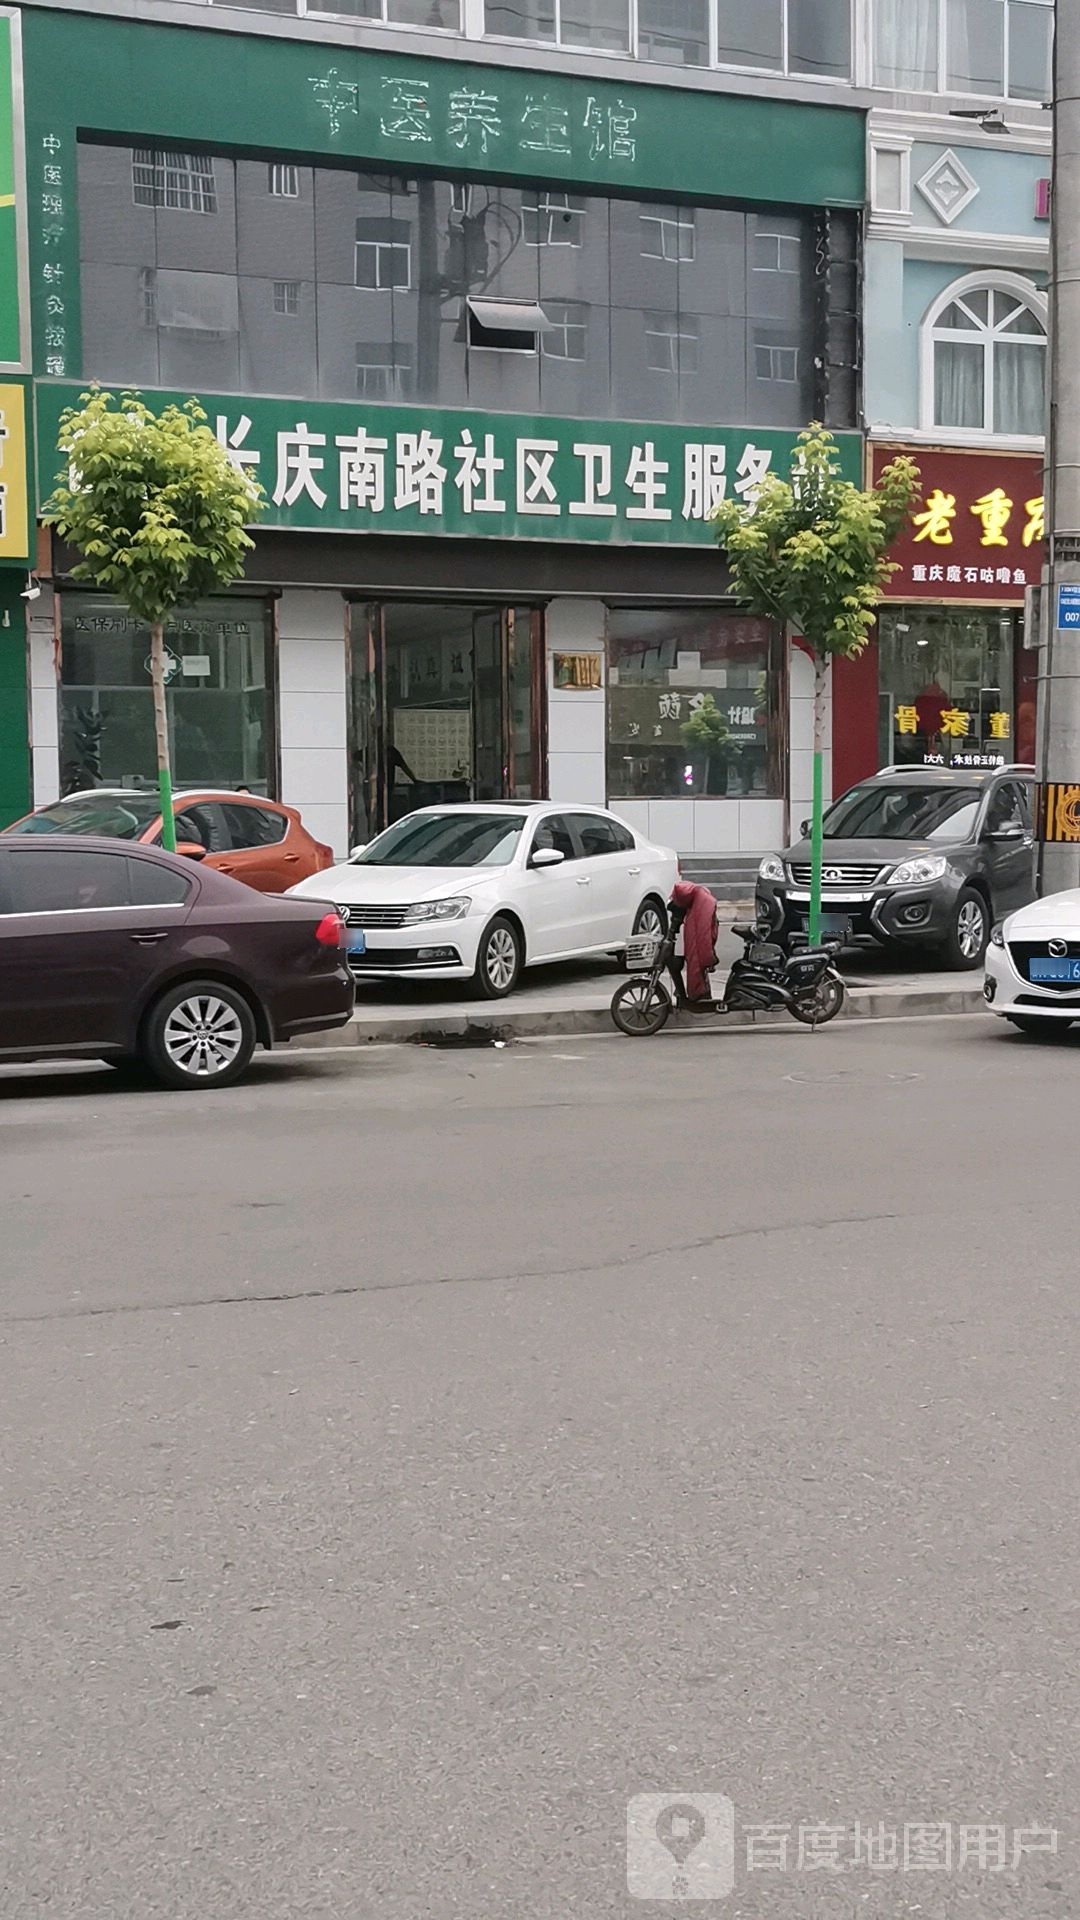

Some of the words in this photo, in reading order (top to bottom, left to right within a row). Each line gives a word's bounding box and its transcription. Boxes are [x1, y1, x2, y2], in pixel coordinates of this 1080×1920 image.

[307, 67, 637, 161] 中医养生馆
[912, 564, 1027, 585] 重庆魔石咕噜鱼
